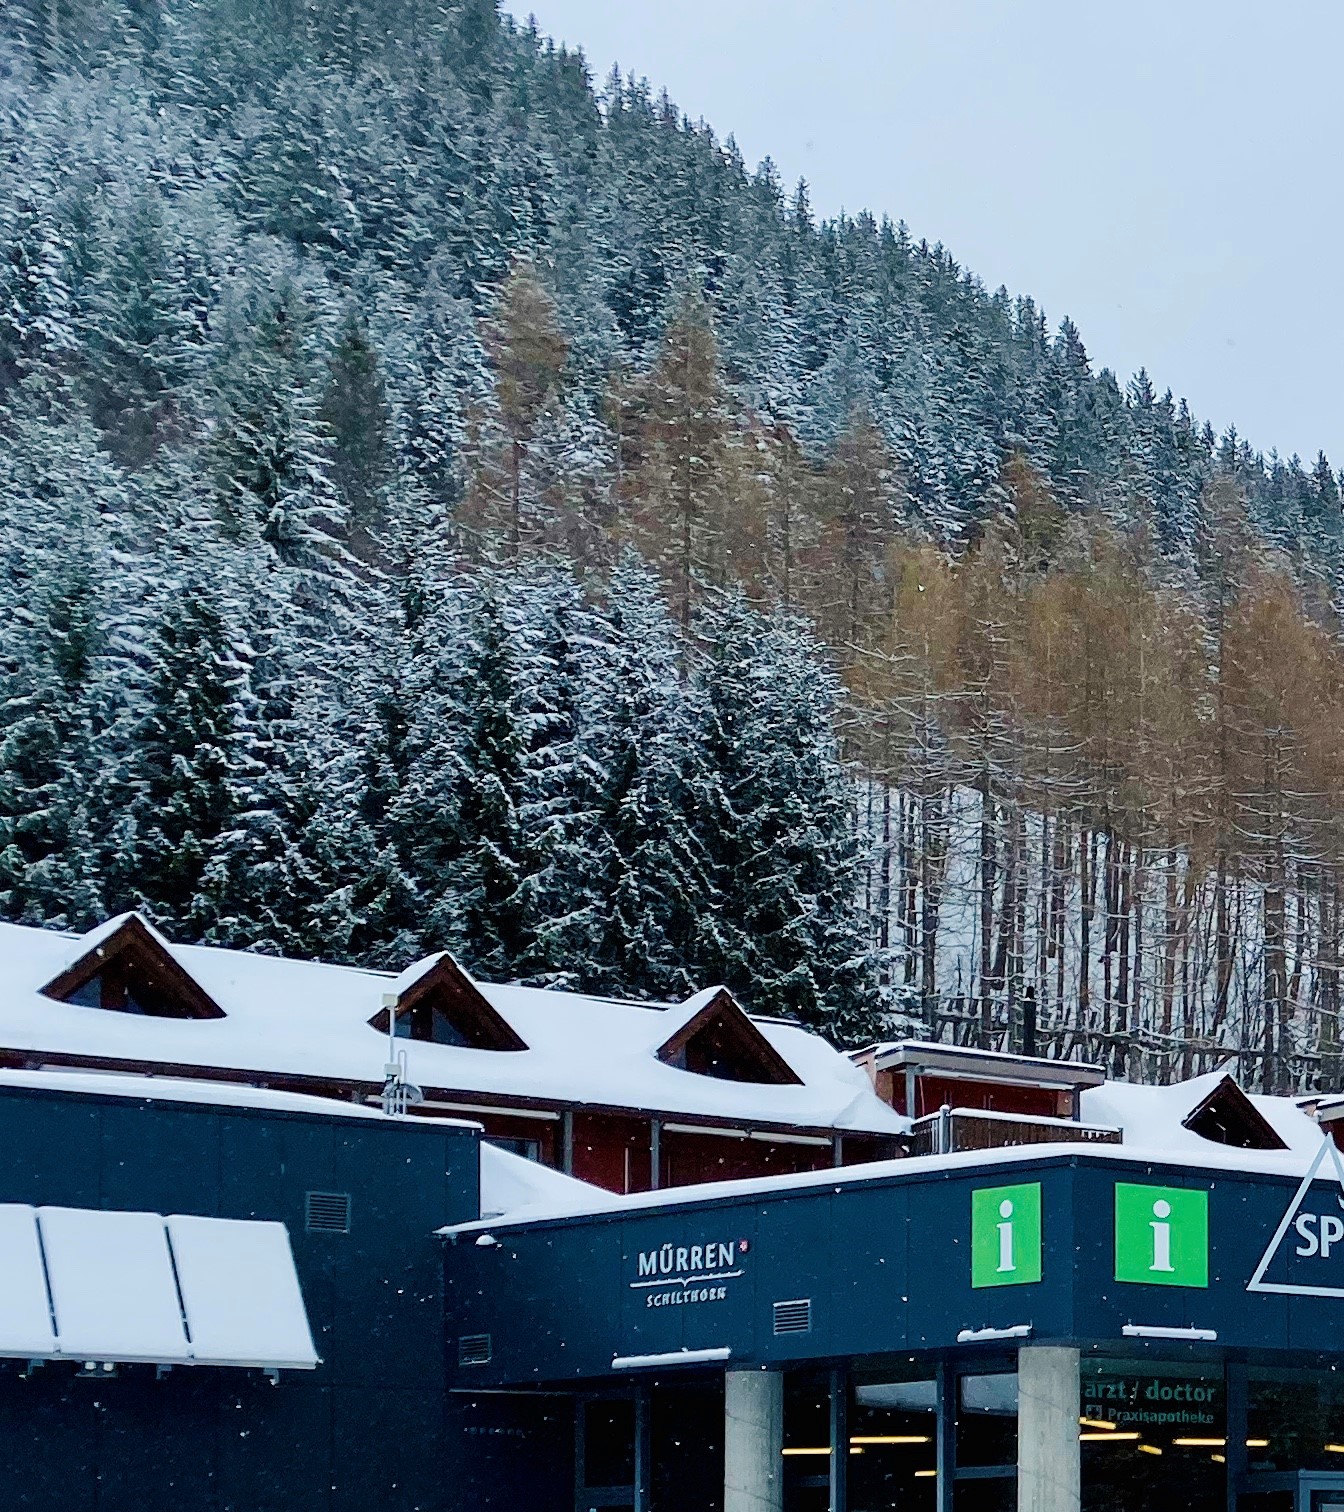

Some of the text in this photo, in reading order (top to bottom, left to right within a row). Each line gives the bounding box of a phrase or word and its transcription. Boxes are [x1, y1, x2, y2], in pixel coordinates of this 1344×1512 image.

[638, 1242, 735, 1276] MÜRREN
[646, 1286, 727, 1308] SCHILTHORN
[1084, 1381, 1127, 1399] arzt
[1145, 1380, 1217, 1401] doctor
[1107, 1407, 1214, 1424] Praxisapotheke
